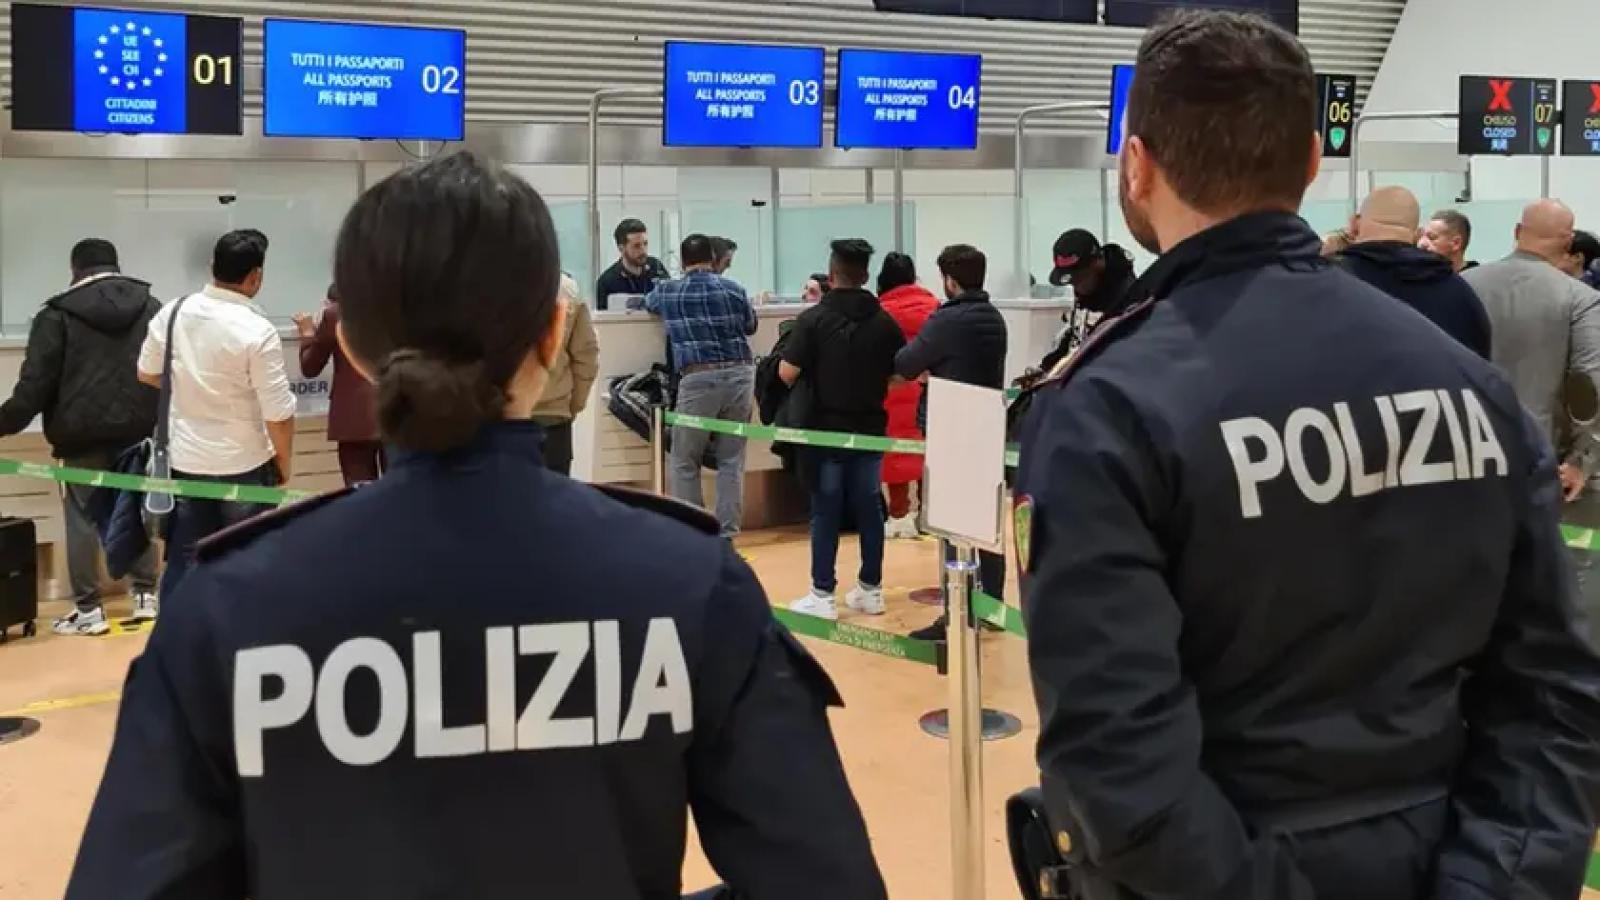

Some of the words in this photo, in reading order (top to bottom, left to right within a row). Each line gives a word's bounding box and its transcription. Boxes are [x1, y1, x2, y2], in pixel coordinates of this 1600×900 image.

[193, 54, 232, 85] 01
[290, 52, 325, 67] TUTTI
[334, 55, 405, 71] PASSAPORTI
[303, 72, 325, 86] ALL
[328, 73, 392, 89] PASSPORTS
[422, 65, 460, 94] 02
[687, 71, 713, 83] TUTTI
[721, 72, 776, 85] PASSAPORTI
[857, 77, 881, 88] TUTTI
[888, 78, 938, 91] PASSAPORTI
[695, 88, 713, 100] ALL
[715, 89, 766, 102] PASSPORTS
[789, 79, 819, 105] 03
[864, 93, 880, 105] ALL
[882, 93, 928, 107] PASSPORTS
[948, 85, 975, 110] 04
[105, 97, 157, 110] CITTADINI
[1329, 101, 1350, 123] 06
[107, 112, 155, 124] CITIZENS
[1535, 104, 1553, 123] 07
[1483, 127, 1517, 138] CLOSED
[1219, 388, 1508, 519] POLIZIA
[233, 617, 694, 777] POLIZIA
